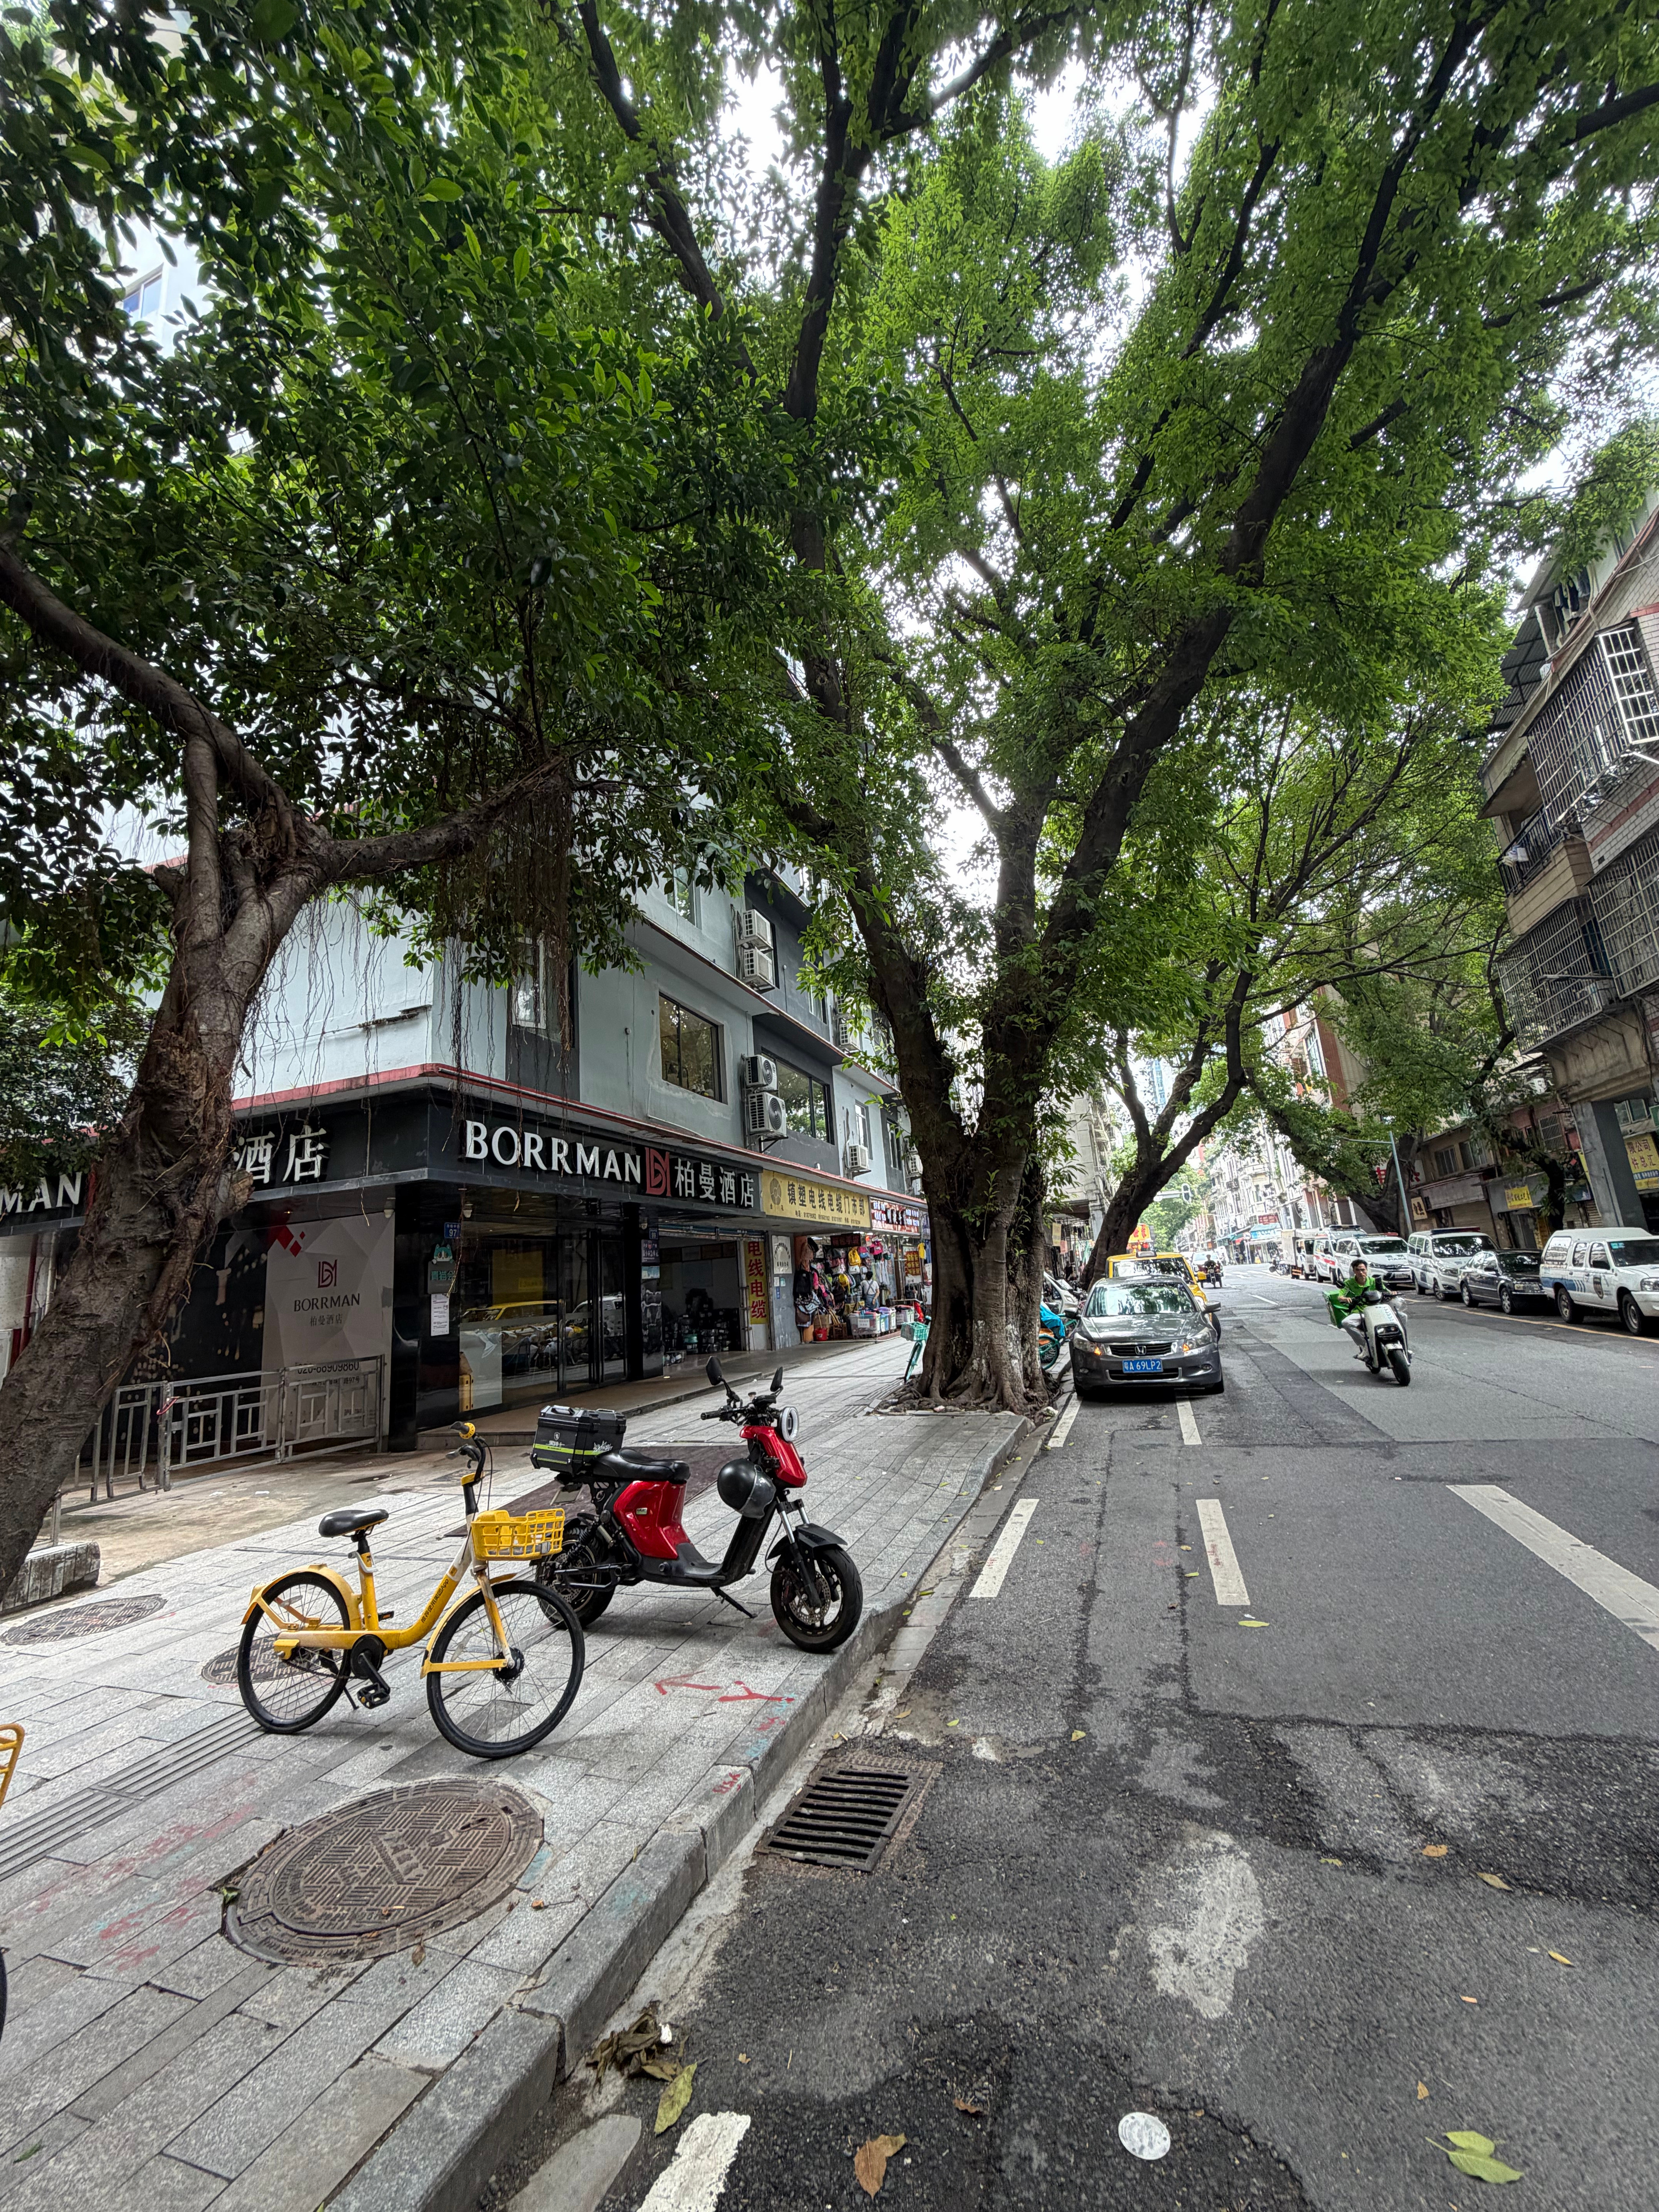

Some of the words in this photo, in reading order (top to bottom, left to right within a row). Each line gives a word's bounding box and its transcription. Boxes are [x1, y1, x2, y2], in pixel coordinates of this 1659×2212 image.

[233, 1125, 326, 1183] 酒店
[465, 1120, 641, 1184] BORRMAN
[675, 1158, 754, 1208] 柏曼酒店
[294, 1293, 360, 1312] BORRMAN
[748, 1241, 766, 1319] 电线电缆
[310, 1313, 342, 1326] 柏曼酒店
